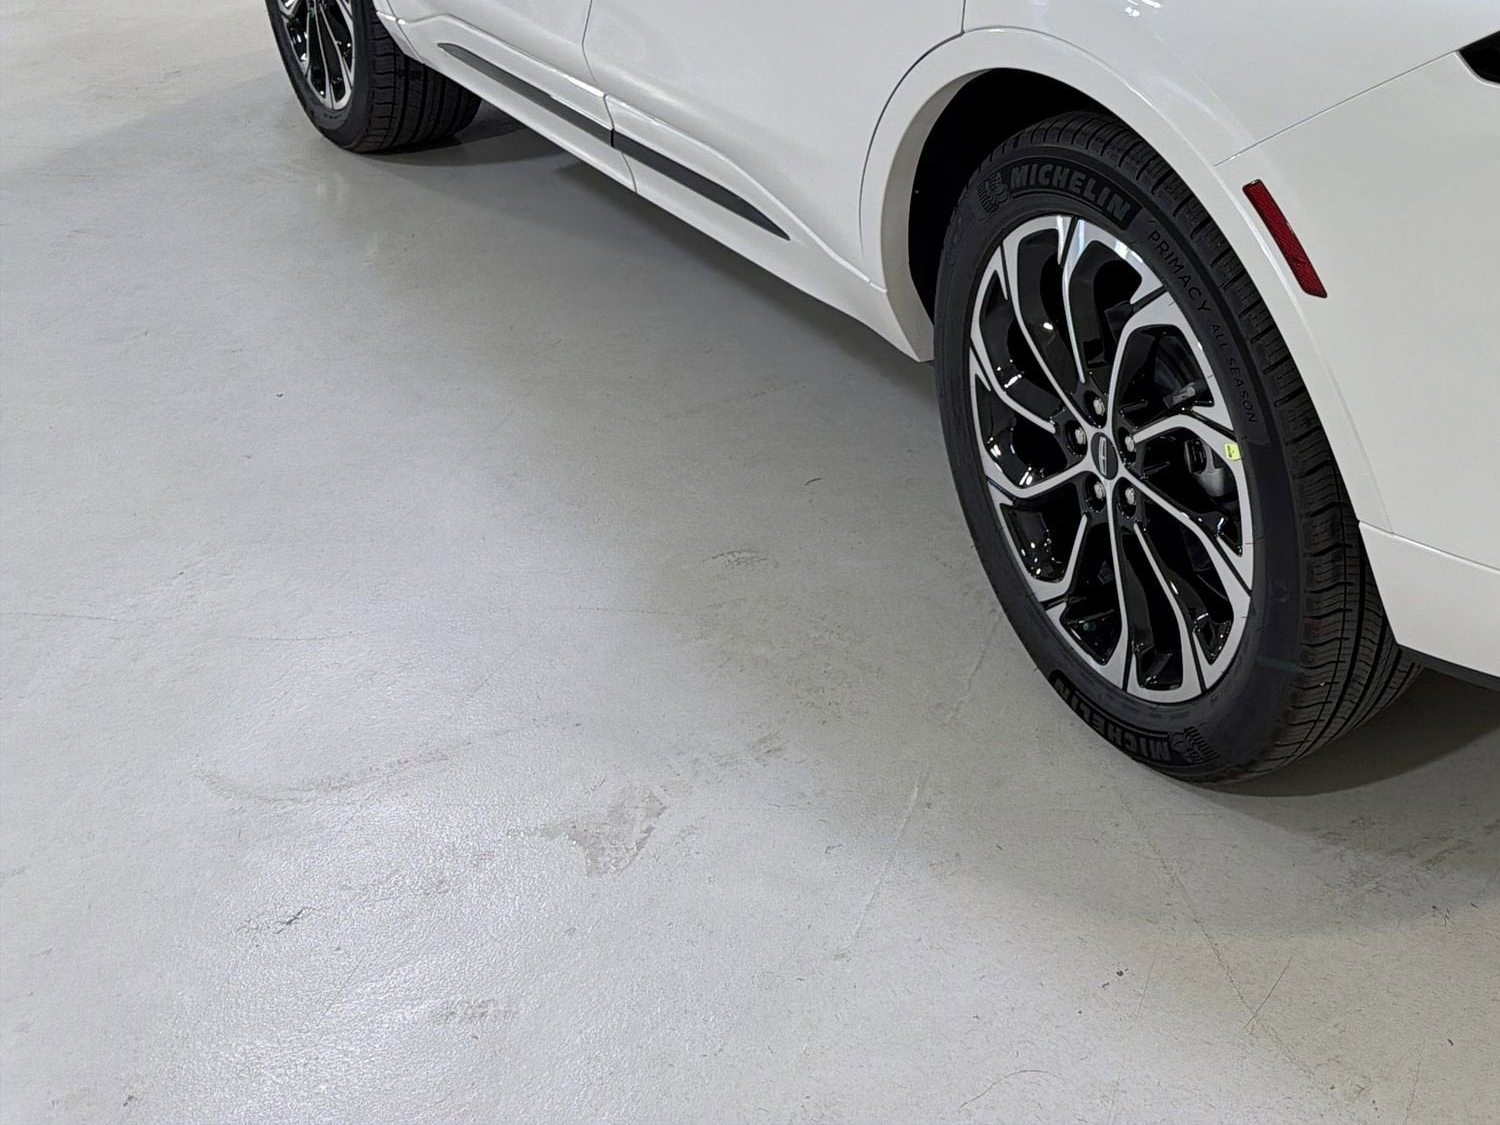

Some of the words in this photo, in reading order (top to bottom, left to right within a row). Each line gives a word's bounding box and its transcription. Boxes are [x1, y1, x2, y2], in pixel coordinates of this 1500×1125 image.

[1009, 162, 1134, 222] MICHELIN
[1146, 230, 1212, 312] PRIMACY
[1208, 322, 1228, 349] ALL
[1226, 355, 1259, 424] SEASON
